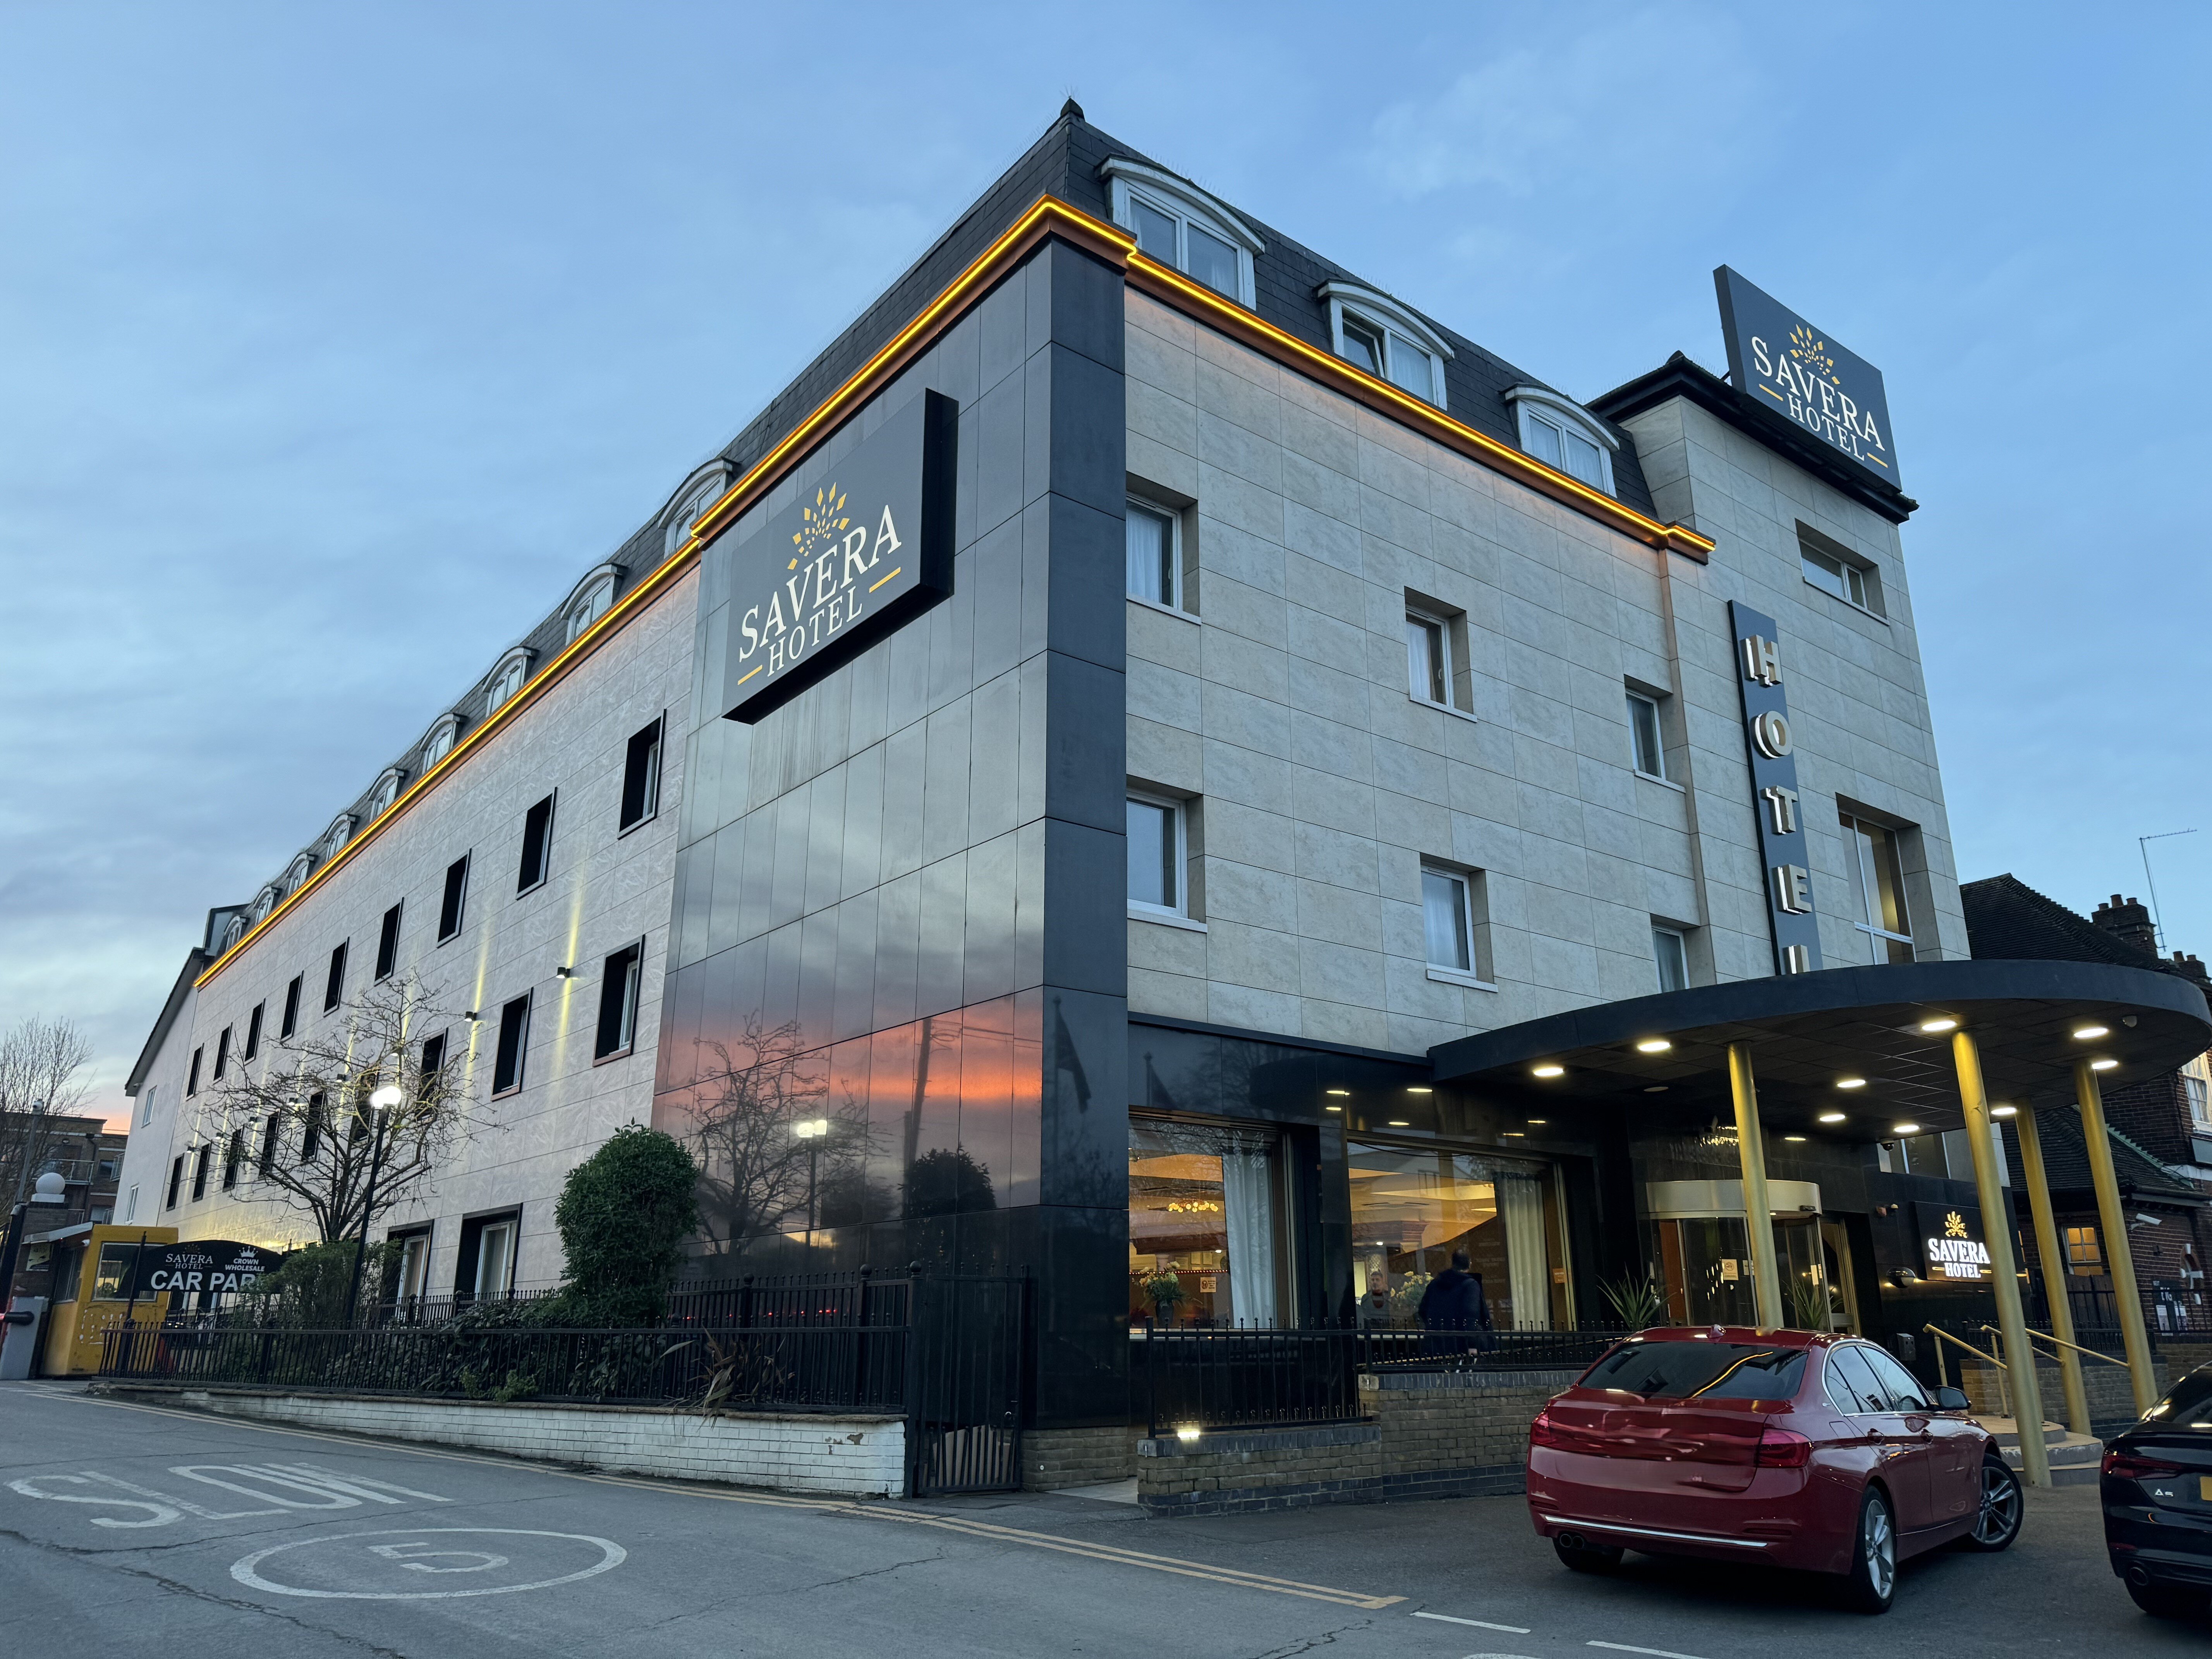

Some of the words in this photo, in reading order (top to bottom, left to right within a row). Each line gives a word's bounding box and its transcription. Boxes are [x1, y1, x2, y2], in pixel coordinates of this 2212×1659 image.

[1752, 336, 1885, 451] SAVERA
[1786, 393, 1865, 461] HOTEL
[739, 505, 902, 663] SAVERA
[767, 586, 862, 677] HOTEL
[165, 1253, 213, 1264] SAVERA
[1928, 1238, 1991, 1264] SAVERA
[151, 1270, 202, 1291] CAR
[209, 1272, 256, 1291] PAR
[1944, 1262, 1981, 1278] HOTEL
[3, 1463, 455, 1528] SLOW
[2154, 1489, 2174, 1497] A5
[367, 1542, 509, 1573] 5
